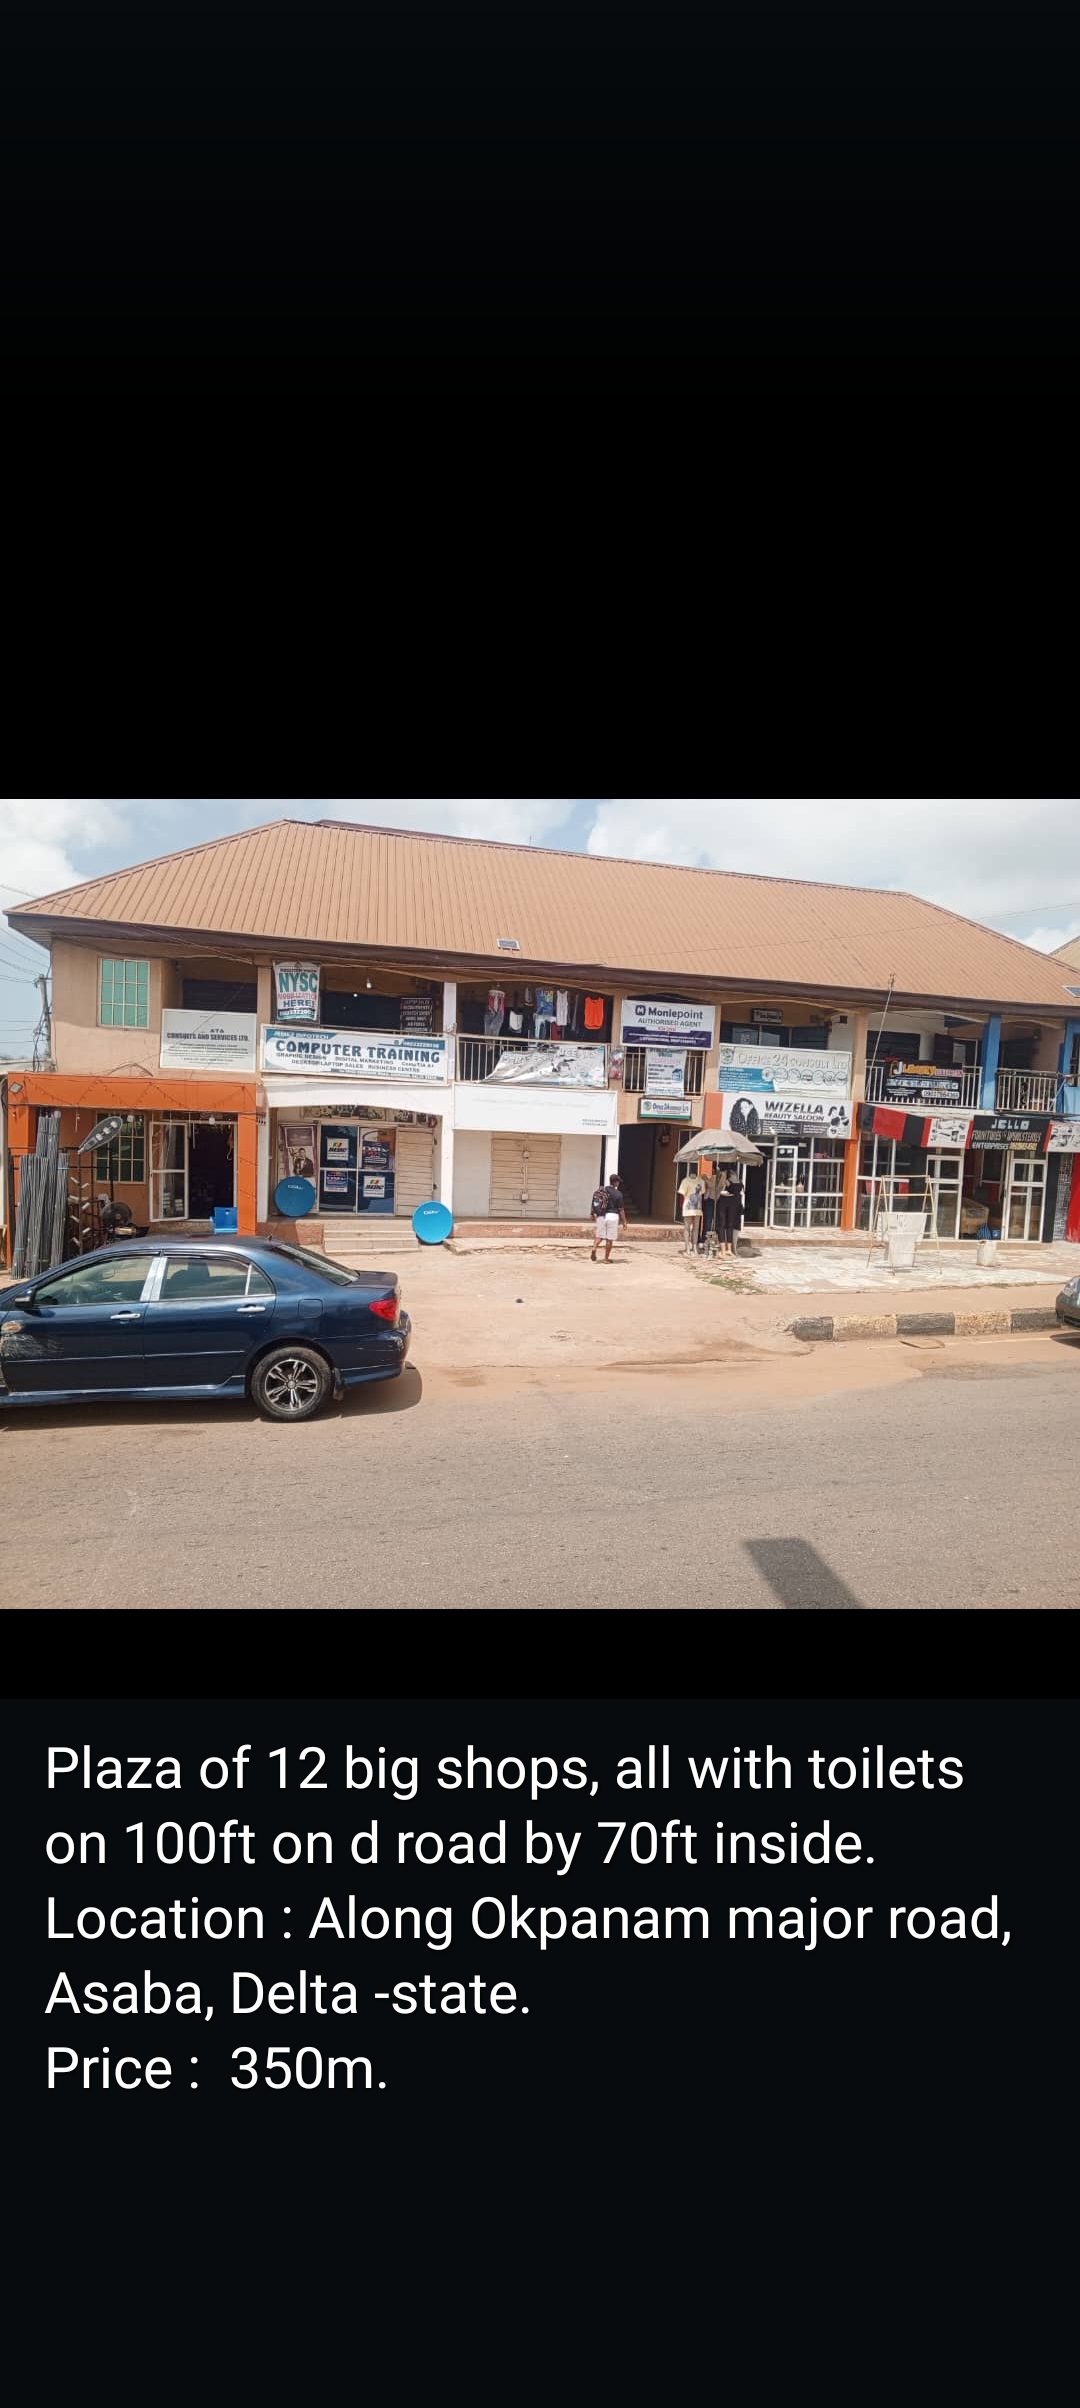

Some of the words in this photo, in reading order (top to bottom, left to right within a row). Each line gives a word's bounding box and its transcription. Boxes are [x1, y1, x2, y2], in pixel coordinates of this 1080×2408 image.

[279, 972, 318, 993] NYSC
[283, 1000, 315, 1008] HERE!
[648, 1006, 703, 1020] Moniepoint
[638, 1018, 679, 1026] AUTHORISED
[680, 1020, 702, 1028] AGENT
[210, 1033, 237, 1041] SERVICES
[275, 1040, 362, 1057] COMPUTER
[366, 1046, 440, 1064] TRAINING
[772, 1053, 788, 1067] 24
[764, 1100, 824, 1115] WIZELLA
[764, 1111, 792, 1119] BEAUTY
[793, 1113, 825, 1122] SALOON
[991, 1118, 1031, 1131] JELLO
[971, 1141, 1010, 1150] ENTERPRISES
